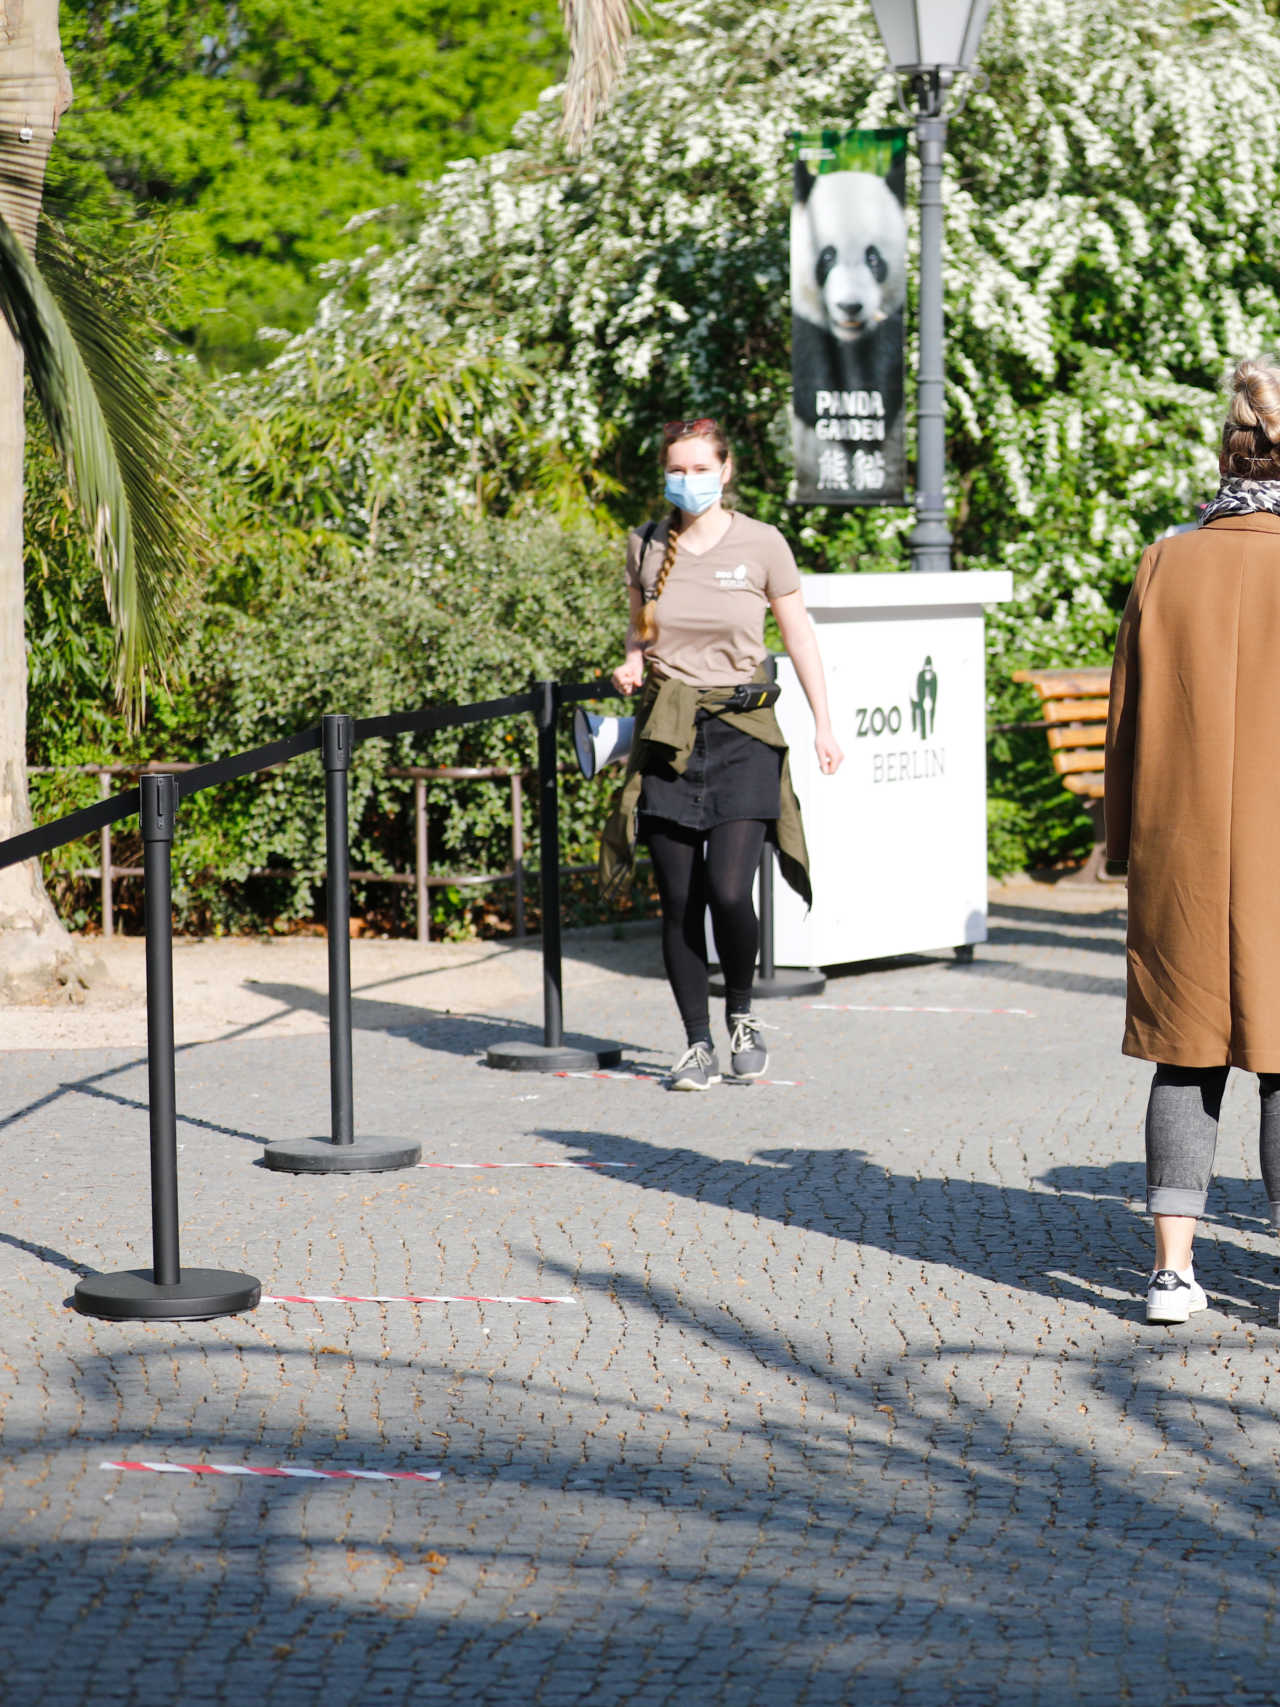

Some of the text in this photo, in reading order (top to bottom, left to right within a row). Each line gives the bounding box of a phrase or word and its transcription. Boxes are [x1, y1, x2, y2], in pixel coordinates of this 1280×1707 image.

[816, 390, 885, 416] PANDA
[855, 705, 902, 738] ZOO
[873, 747, 945, 784] BERLIN
